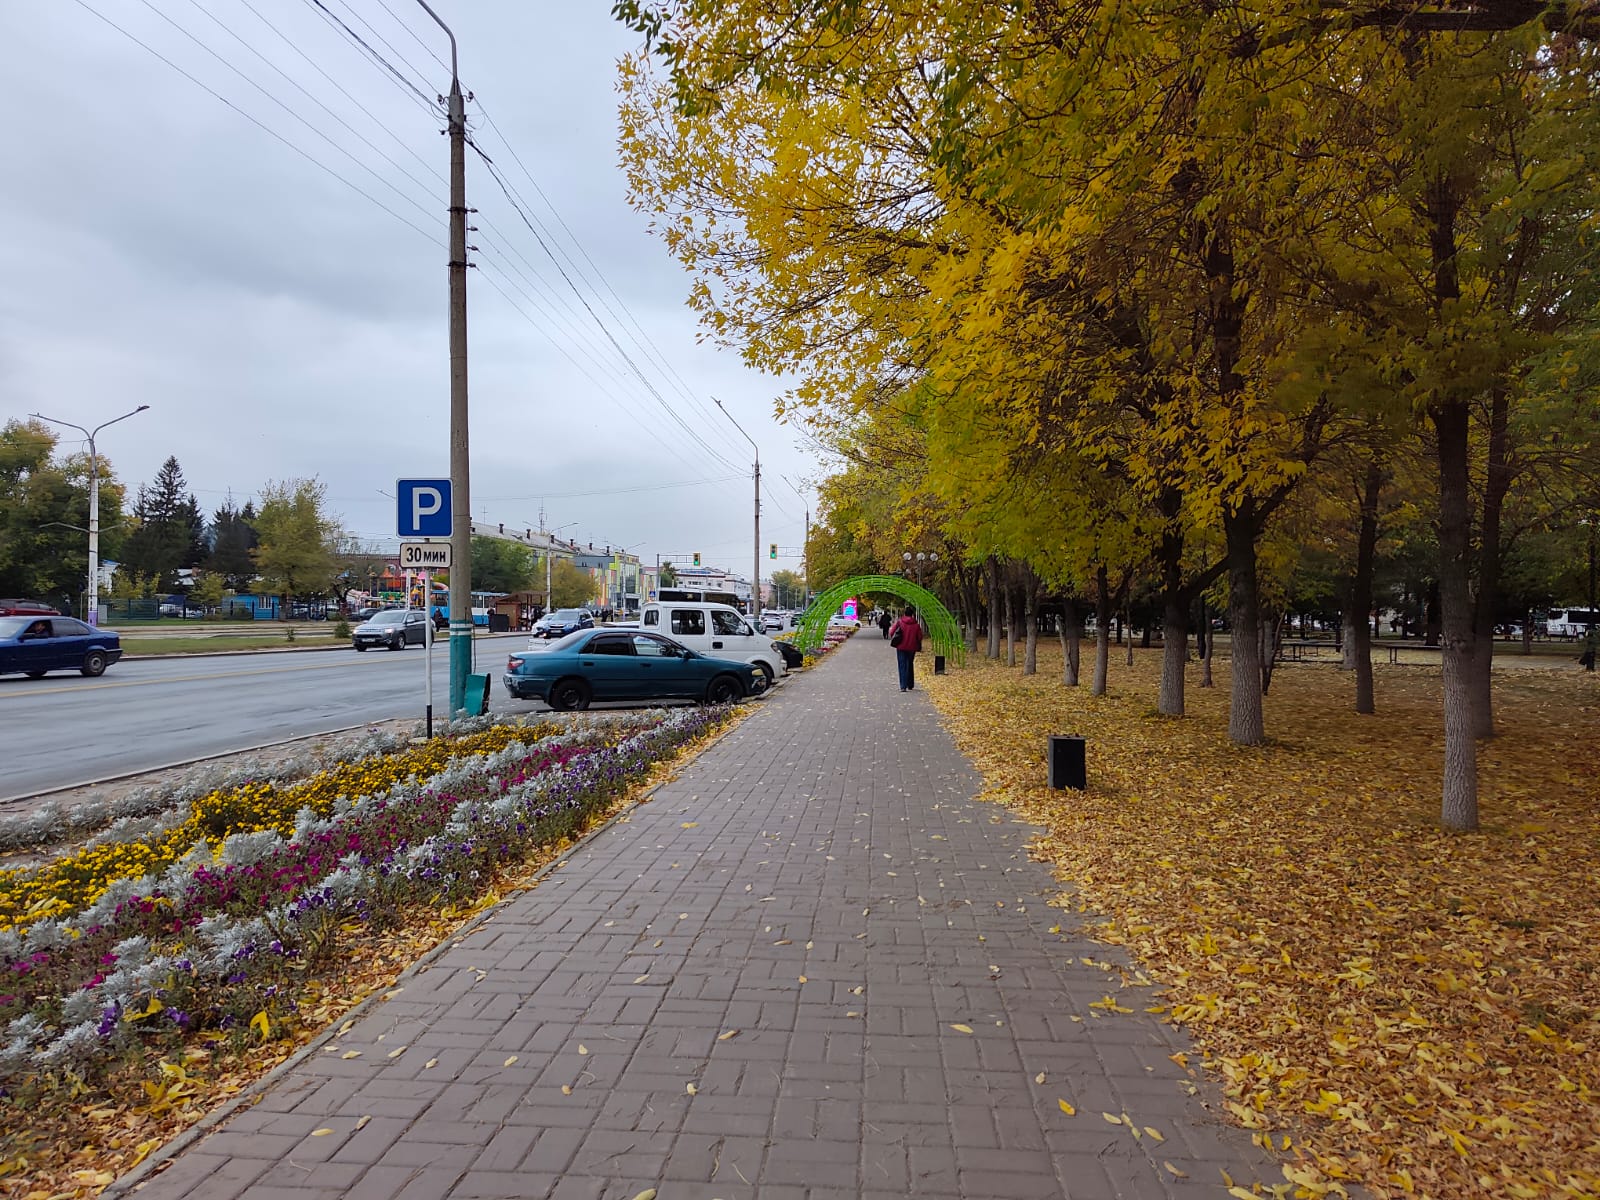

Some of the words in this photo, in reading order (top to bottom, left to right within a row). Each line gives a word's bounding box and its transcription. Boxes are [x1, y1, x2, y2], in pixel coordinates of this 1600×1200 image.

[412, 486, 442, 531] P
[406, 547, 422, 562] 30
[423, 551, 446, 563] мин
